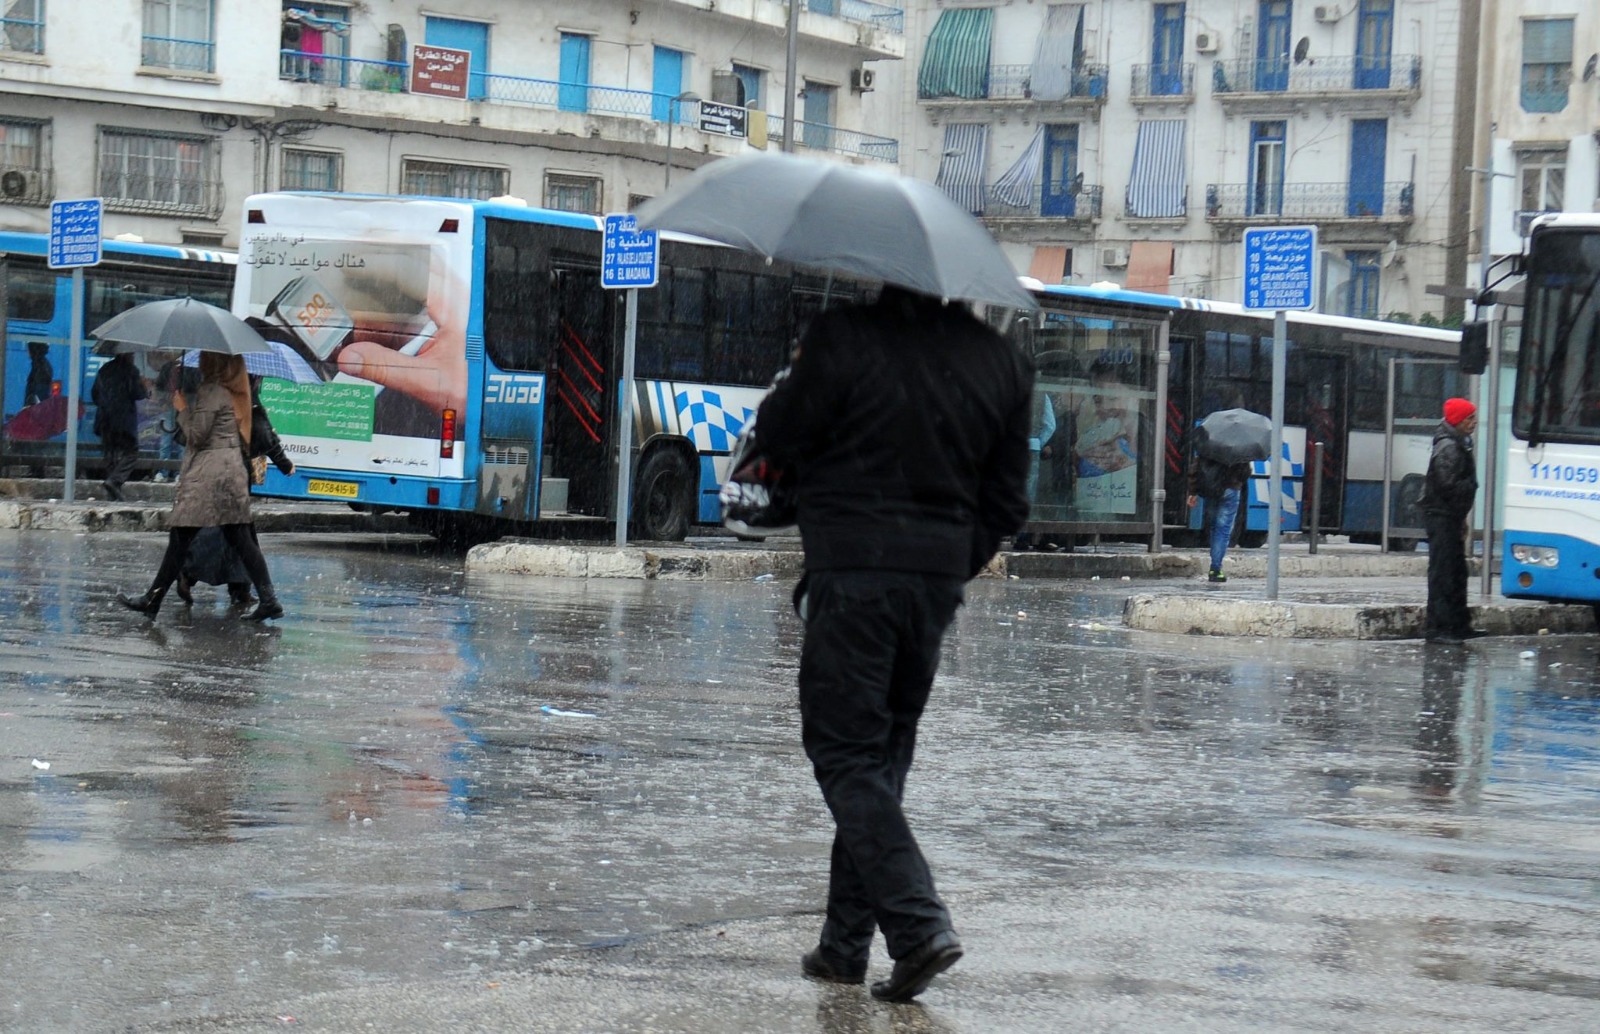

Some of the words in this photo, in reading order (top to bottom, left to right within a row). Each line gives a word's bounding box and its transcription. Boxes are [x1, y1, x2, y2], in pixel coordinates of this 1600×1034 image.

[607, 223, 616, 234] 27
[290, 233, 304, 246] في
[607, 238, 616, 248] 16
[619, 235, 653, 250] المدنية
[279, 252, 287, 266] لا
[289, 252, 329, 271] مواعيد
[334, 252, 366, 268] هناك
[606, 253, 615, 264] 27
[605, 269, 614, 280] 16
[618, 268, 625, 280] EL
[626, 266, 650, 280] MADANIA
[1286, 272, 1308, 280] POSTE
[297, 293, 325, 326] 500
[264, 382, 282, 391] 2016
[1531, 464, 1598, 483] 111059
